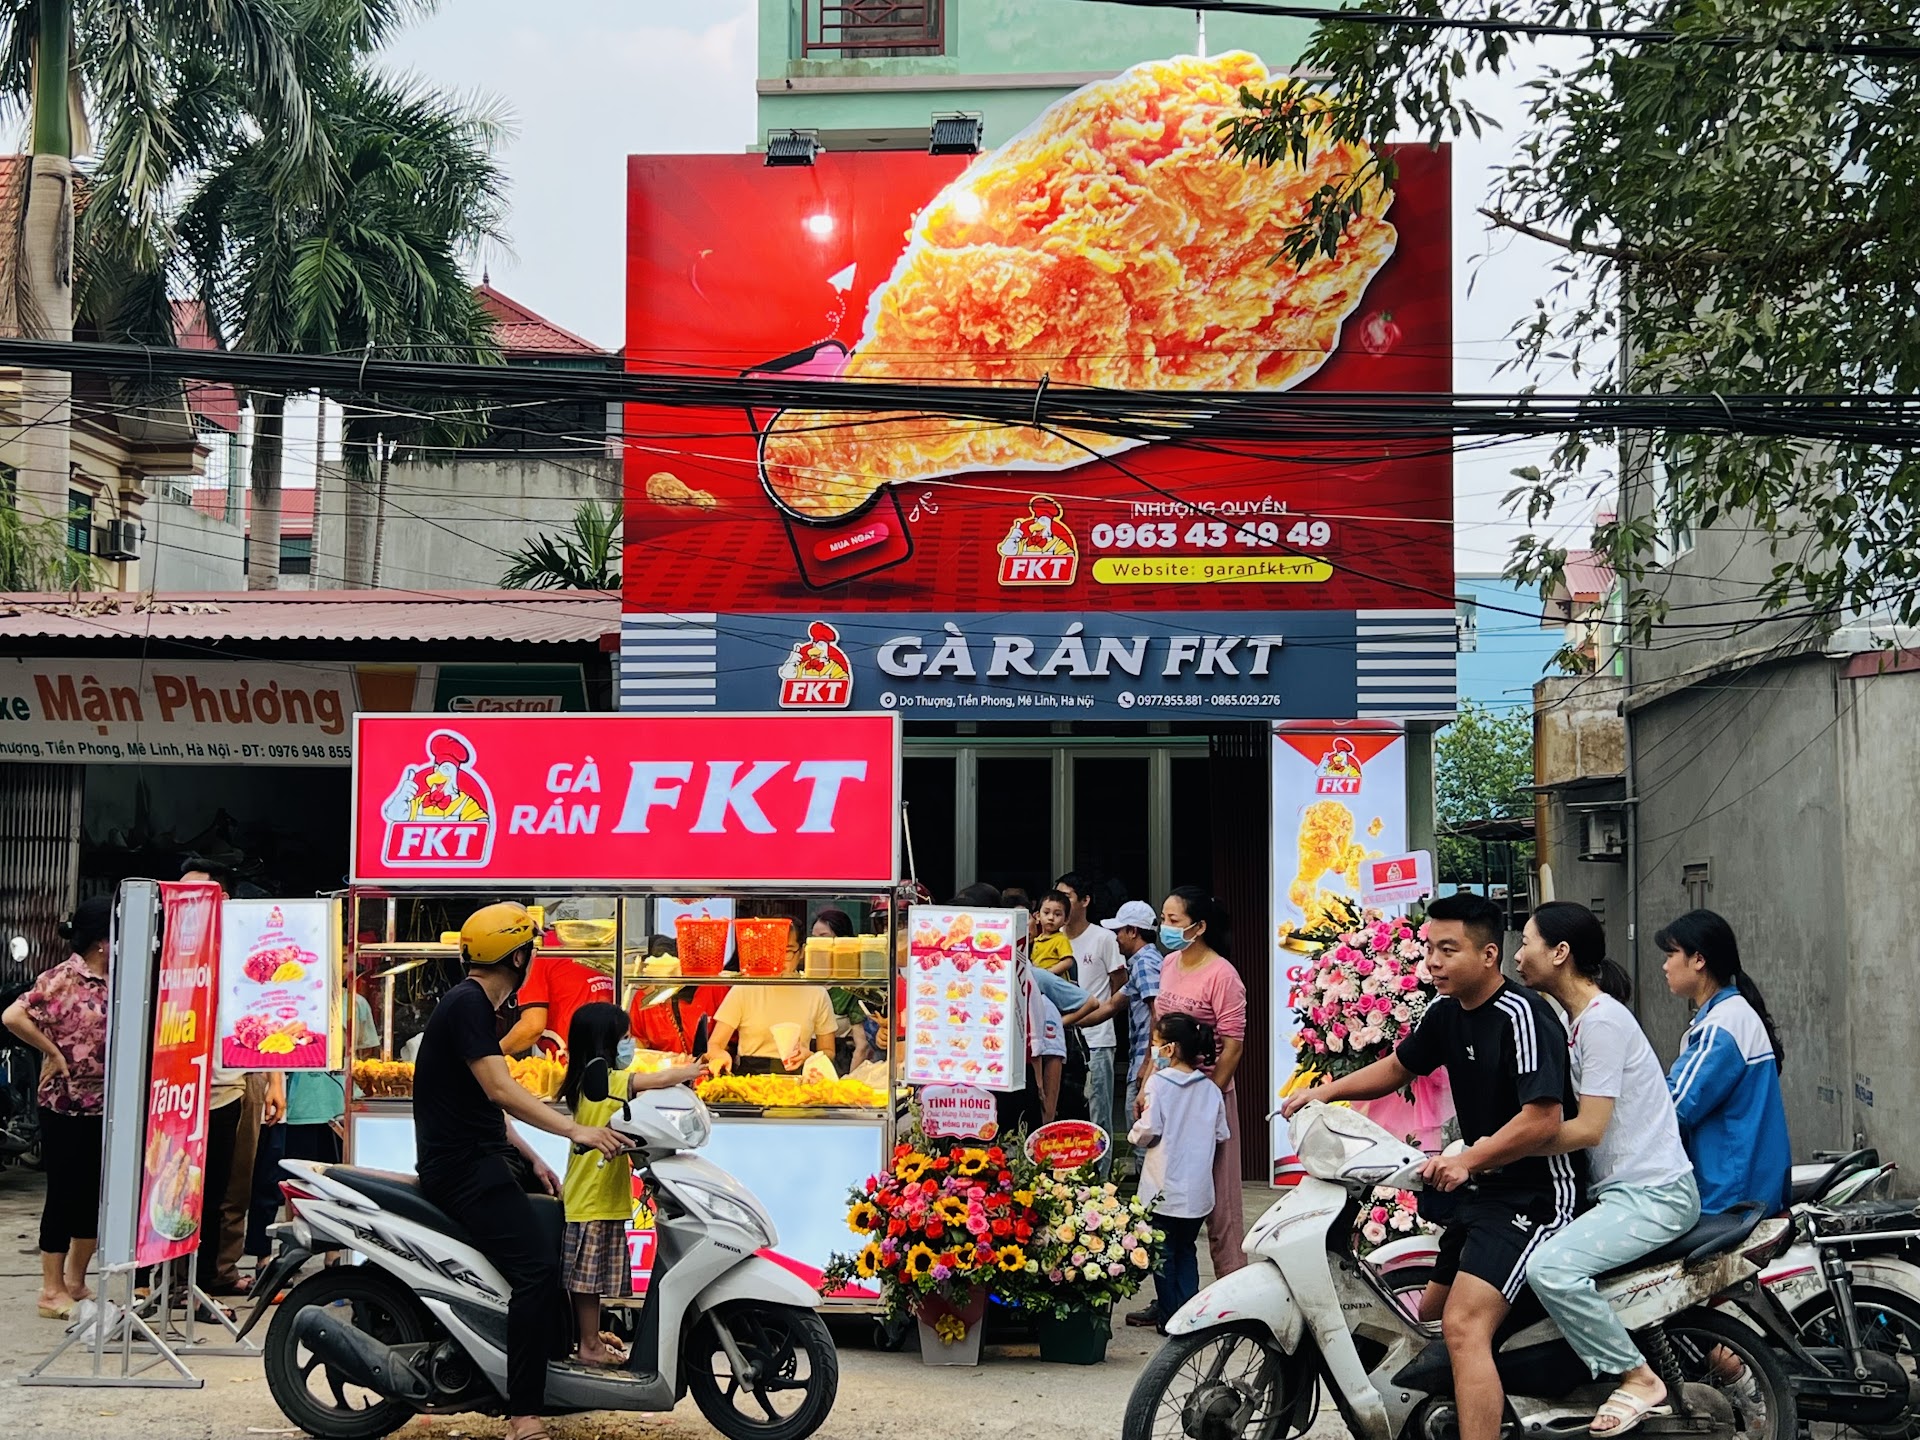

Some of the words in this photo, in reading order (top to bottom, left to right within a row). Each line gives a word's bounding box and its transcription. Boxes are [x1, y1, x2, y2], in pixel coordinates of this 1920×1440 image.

[829, 539, 850, 552] MUA
[850, 530, 876, 545] NGAY
[1091, 522, 1177, 548] 0963
[1184, 522, 1228, 548] 43
[1234, 521, 1279, 547] 49
[1286, 520, 1331, 547] 49
[1009, 558, 1068, 579] FKT
[1113, 563, 1195, 577] Website:
[1203, 561, 1314, 578] garanfkt.vn
[877, 621, 976, 676] GÀ
[985, 621, 1150, 677] RÁN
[1161, 634, 1283, 676] FKT
[789, 681, 843, 702] FKT
[899, 695, 914, 706] Do
[981, 695, 1015, 708] Phong,
[1017, 694, 1032, 706] Mê
[1034, 694, 1058, 708] Linh,
[1061, 694, 1075, 706] Hà
[1076, 693, 1095, 708] Nội
[1137, 694, 1203, 706] 0977.955.881
[1210, 694, 1281, 706] 0865.029.276
[33, 674, 144, 736] Mận
[152, 674, 345, 736] Phương
[476, 698, 554, 712] Castrol
[0, 742, 44, 757] hượng,
[45, 739, 75, 754] Tiền
[78, 741, 125, 758] Phong,
[127, 742, 147, 755] Mê
[149, 742, 184, 758] Linh,
[185, 743, 204, 757] Hà
[207, 743, 231, 759] Nội
[242, 744, 265, 757] ĐT:
[268, 745, 299, 757] 0976
[302, 745, 326, 758] 948
[328, 745, 352, 758] 855
[545, 756, 602, 793] GÀ
[1320, 778, 1358, 792] FKT
[612, 760, 868, 834] FKT
[508, 792, 601, 835] RÁN
[397, 826, 479, 857] FKT
[158, 968, 181, 990] KHAI
[158, 1001, 197, 1046] Mua
[151, 1077, 197, 1122] Tặng
[714, 1240, 742, 1254] HONDA
